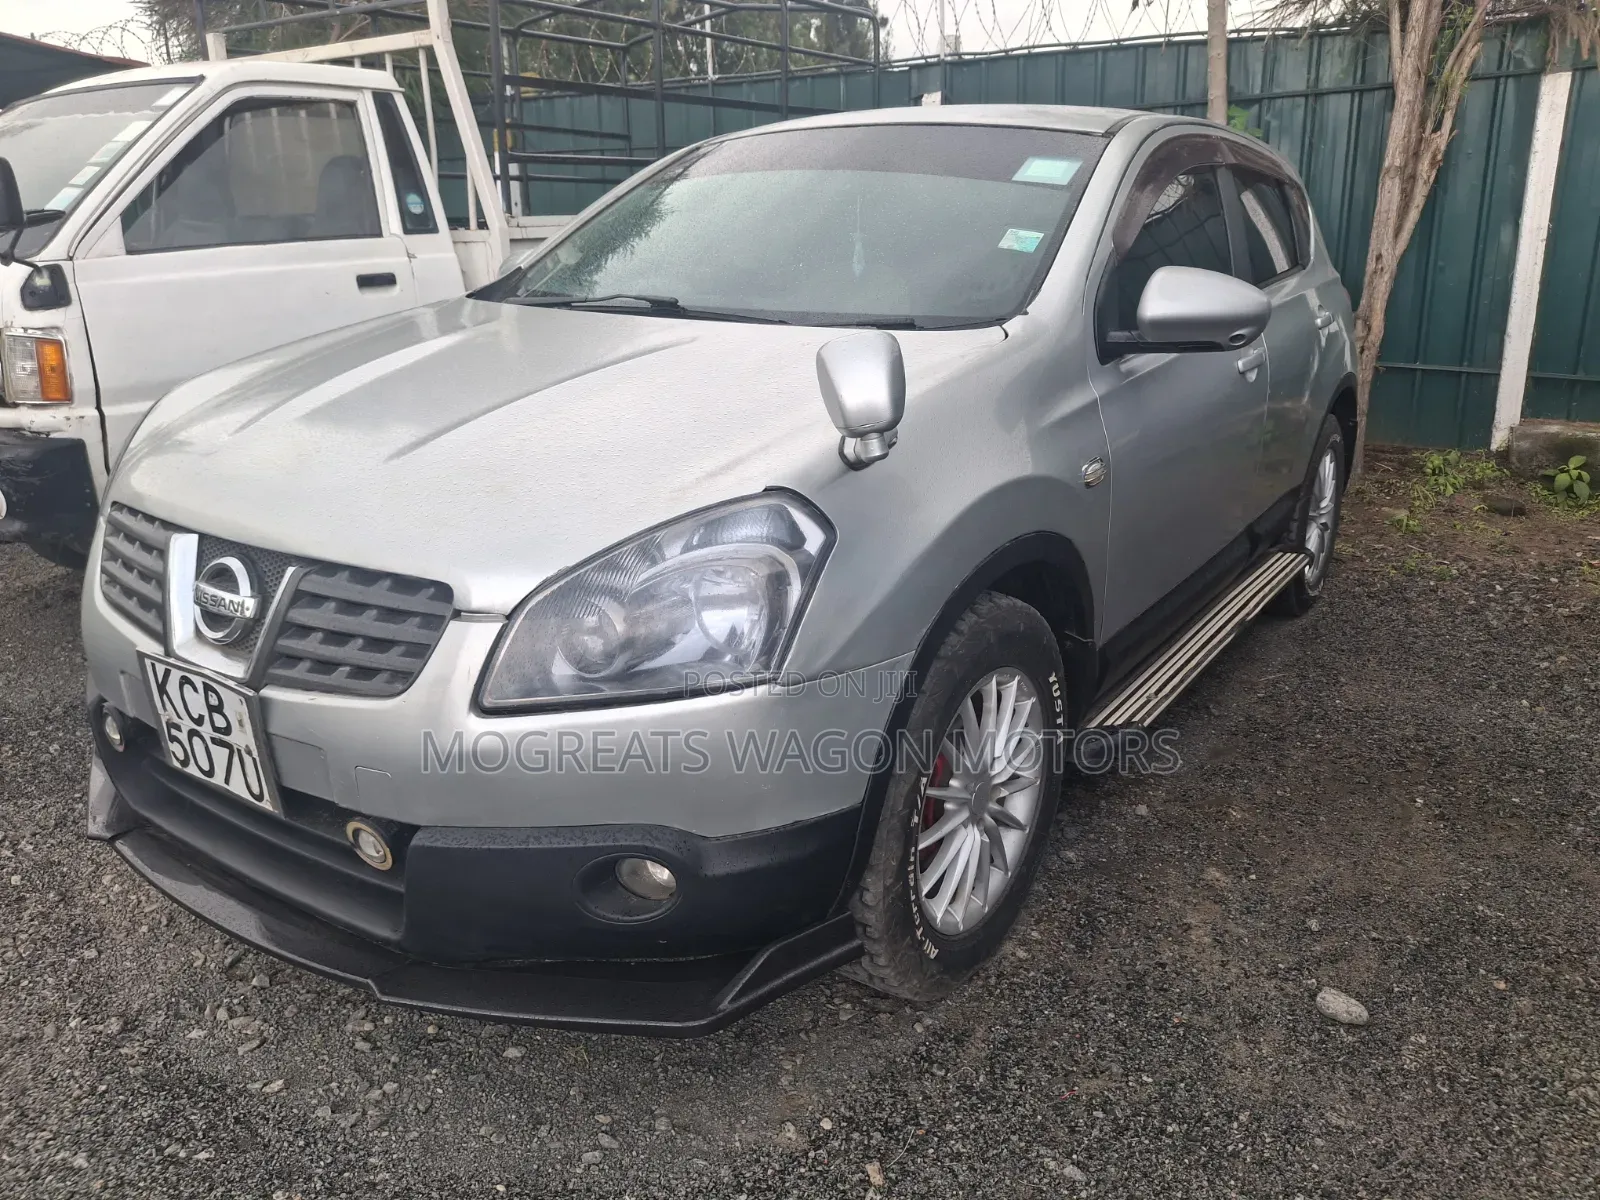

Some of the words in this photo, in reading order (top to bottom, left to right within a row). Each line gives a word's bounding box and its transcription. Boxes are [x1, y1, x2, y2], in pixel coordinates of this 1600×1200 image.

[195, 585, 242, 614] NISSAN
[151, 662, 232, 737] KCB
[1047, 671, 1064, 746] YUSTA
[166, 722, 265, 803] 507U
